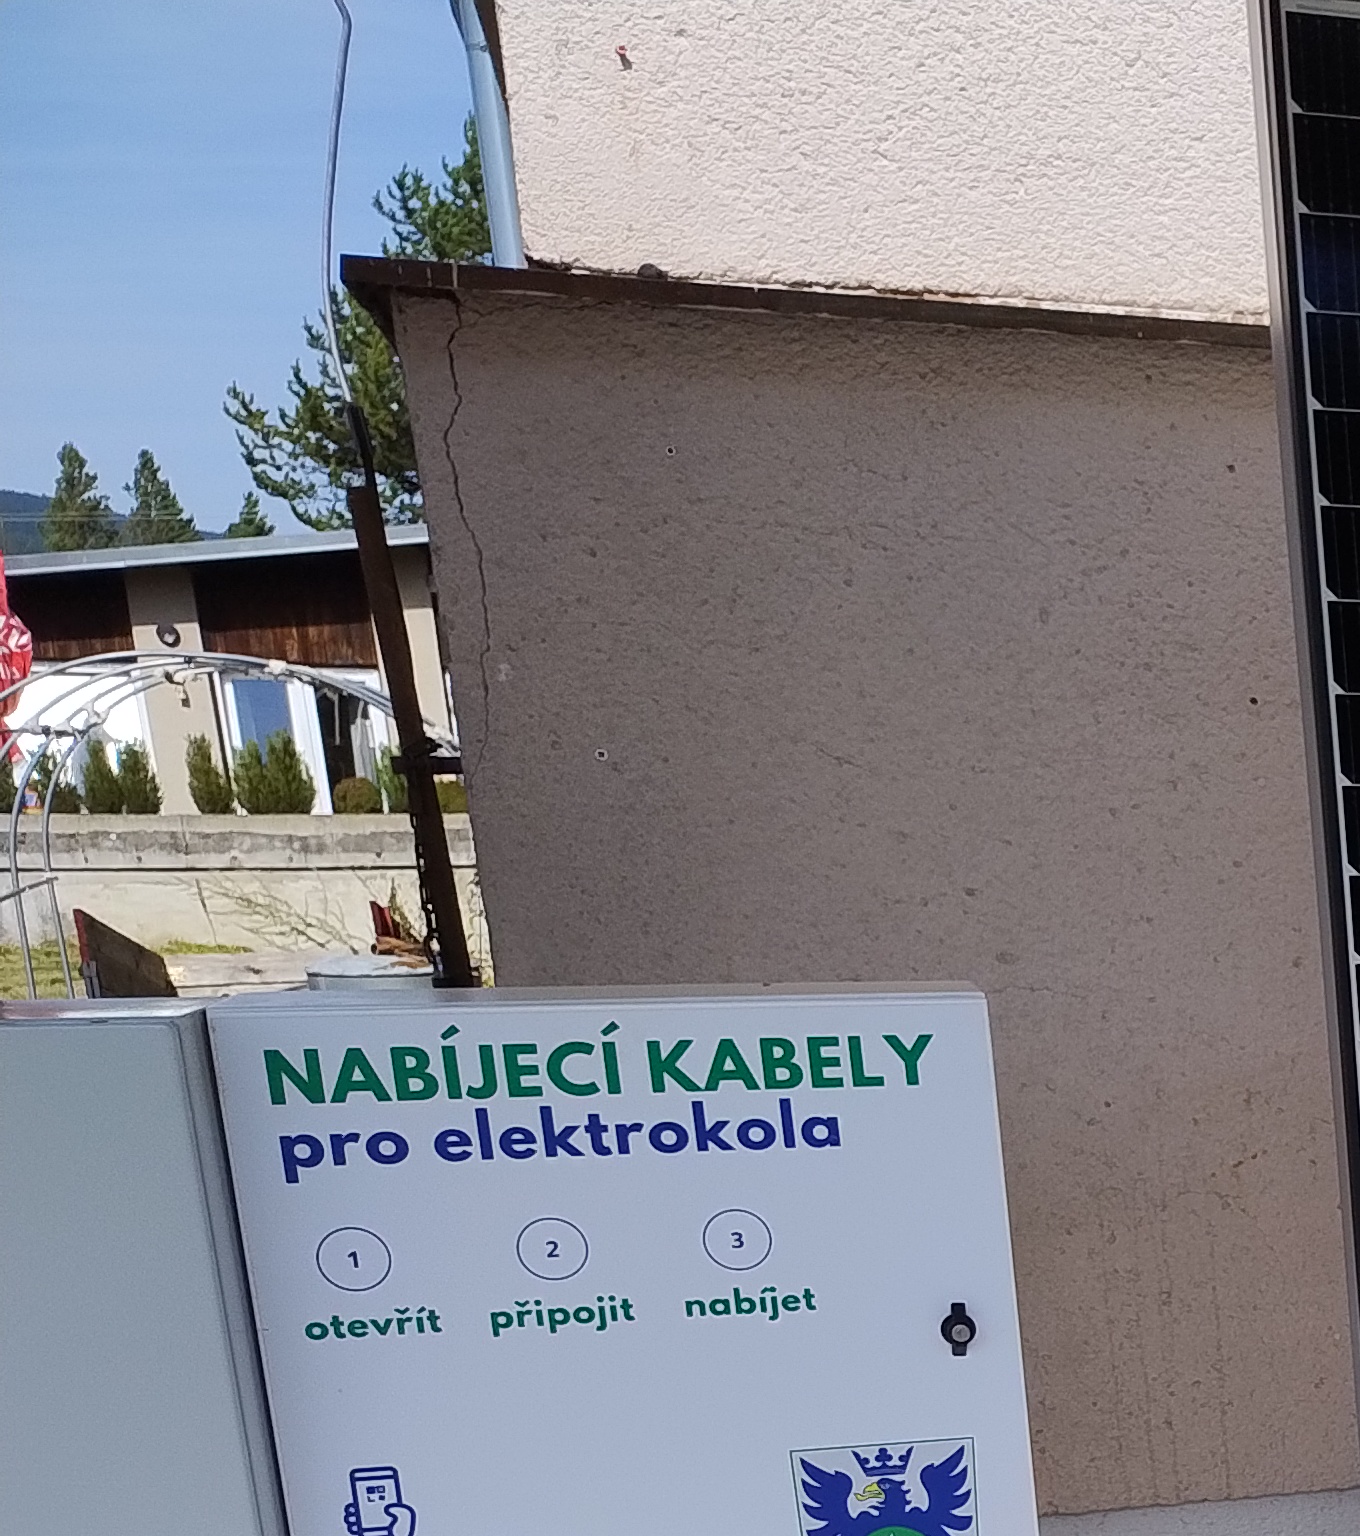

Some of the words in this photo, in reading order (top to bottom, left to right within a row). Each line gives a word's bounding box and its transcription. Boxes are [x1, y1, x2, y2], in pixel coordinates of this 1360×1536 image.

[263, 1021, 622, 1105] NABÍJECÍ
[647, 1034, 933, 1093] KABELY
[279, 1132, 409, 1184] pro
[434, 1098, 841, 1162] elektrokola
[545, 1239, 561, 1259] 2
[730, 1230, 745, 1250] 3
[346, 1249, 361, 1269] 1
[490, 1295, 635, 1337] připojit
[685, 1286, 816, 1321] nabíjet
[305, 1306, 442, 1340] otevřít
